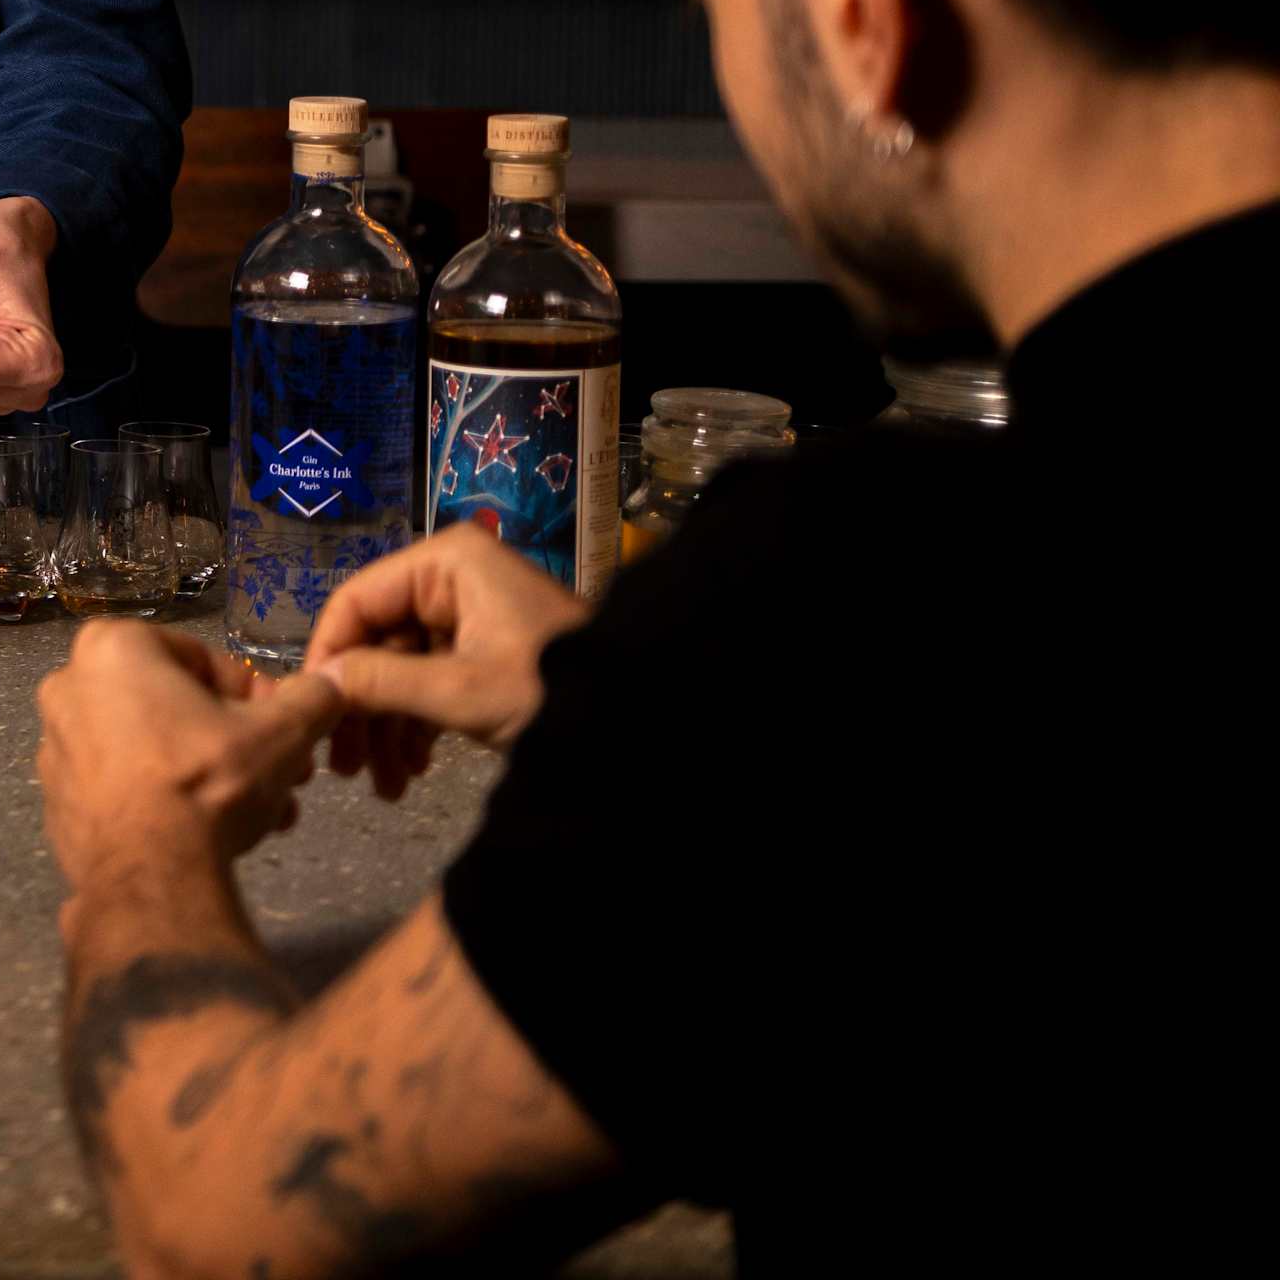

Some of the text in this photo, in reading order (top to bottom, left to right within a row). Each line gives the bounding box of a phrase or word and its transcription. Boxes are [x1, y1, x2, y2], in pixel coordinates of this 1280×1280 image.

[302, 455, 318, 465] Gin
[269, 463, 352, 479] Charlotte's Ink
[298, 480, 320, 491] Paris
